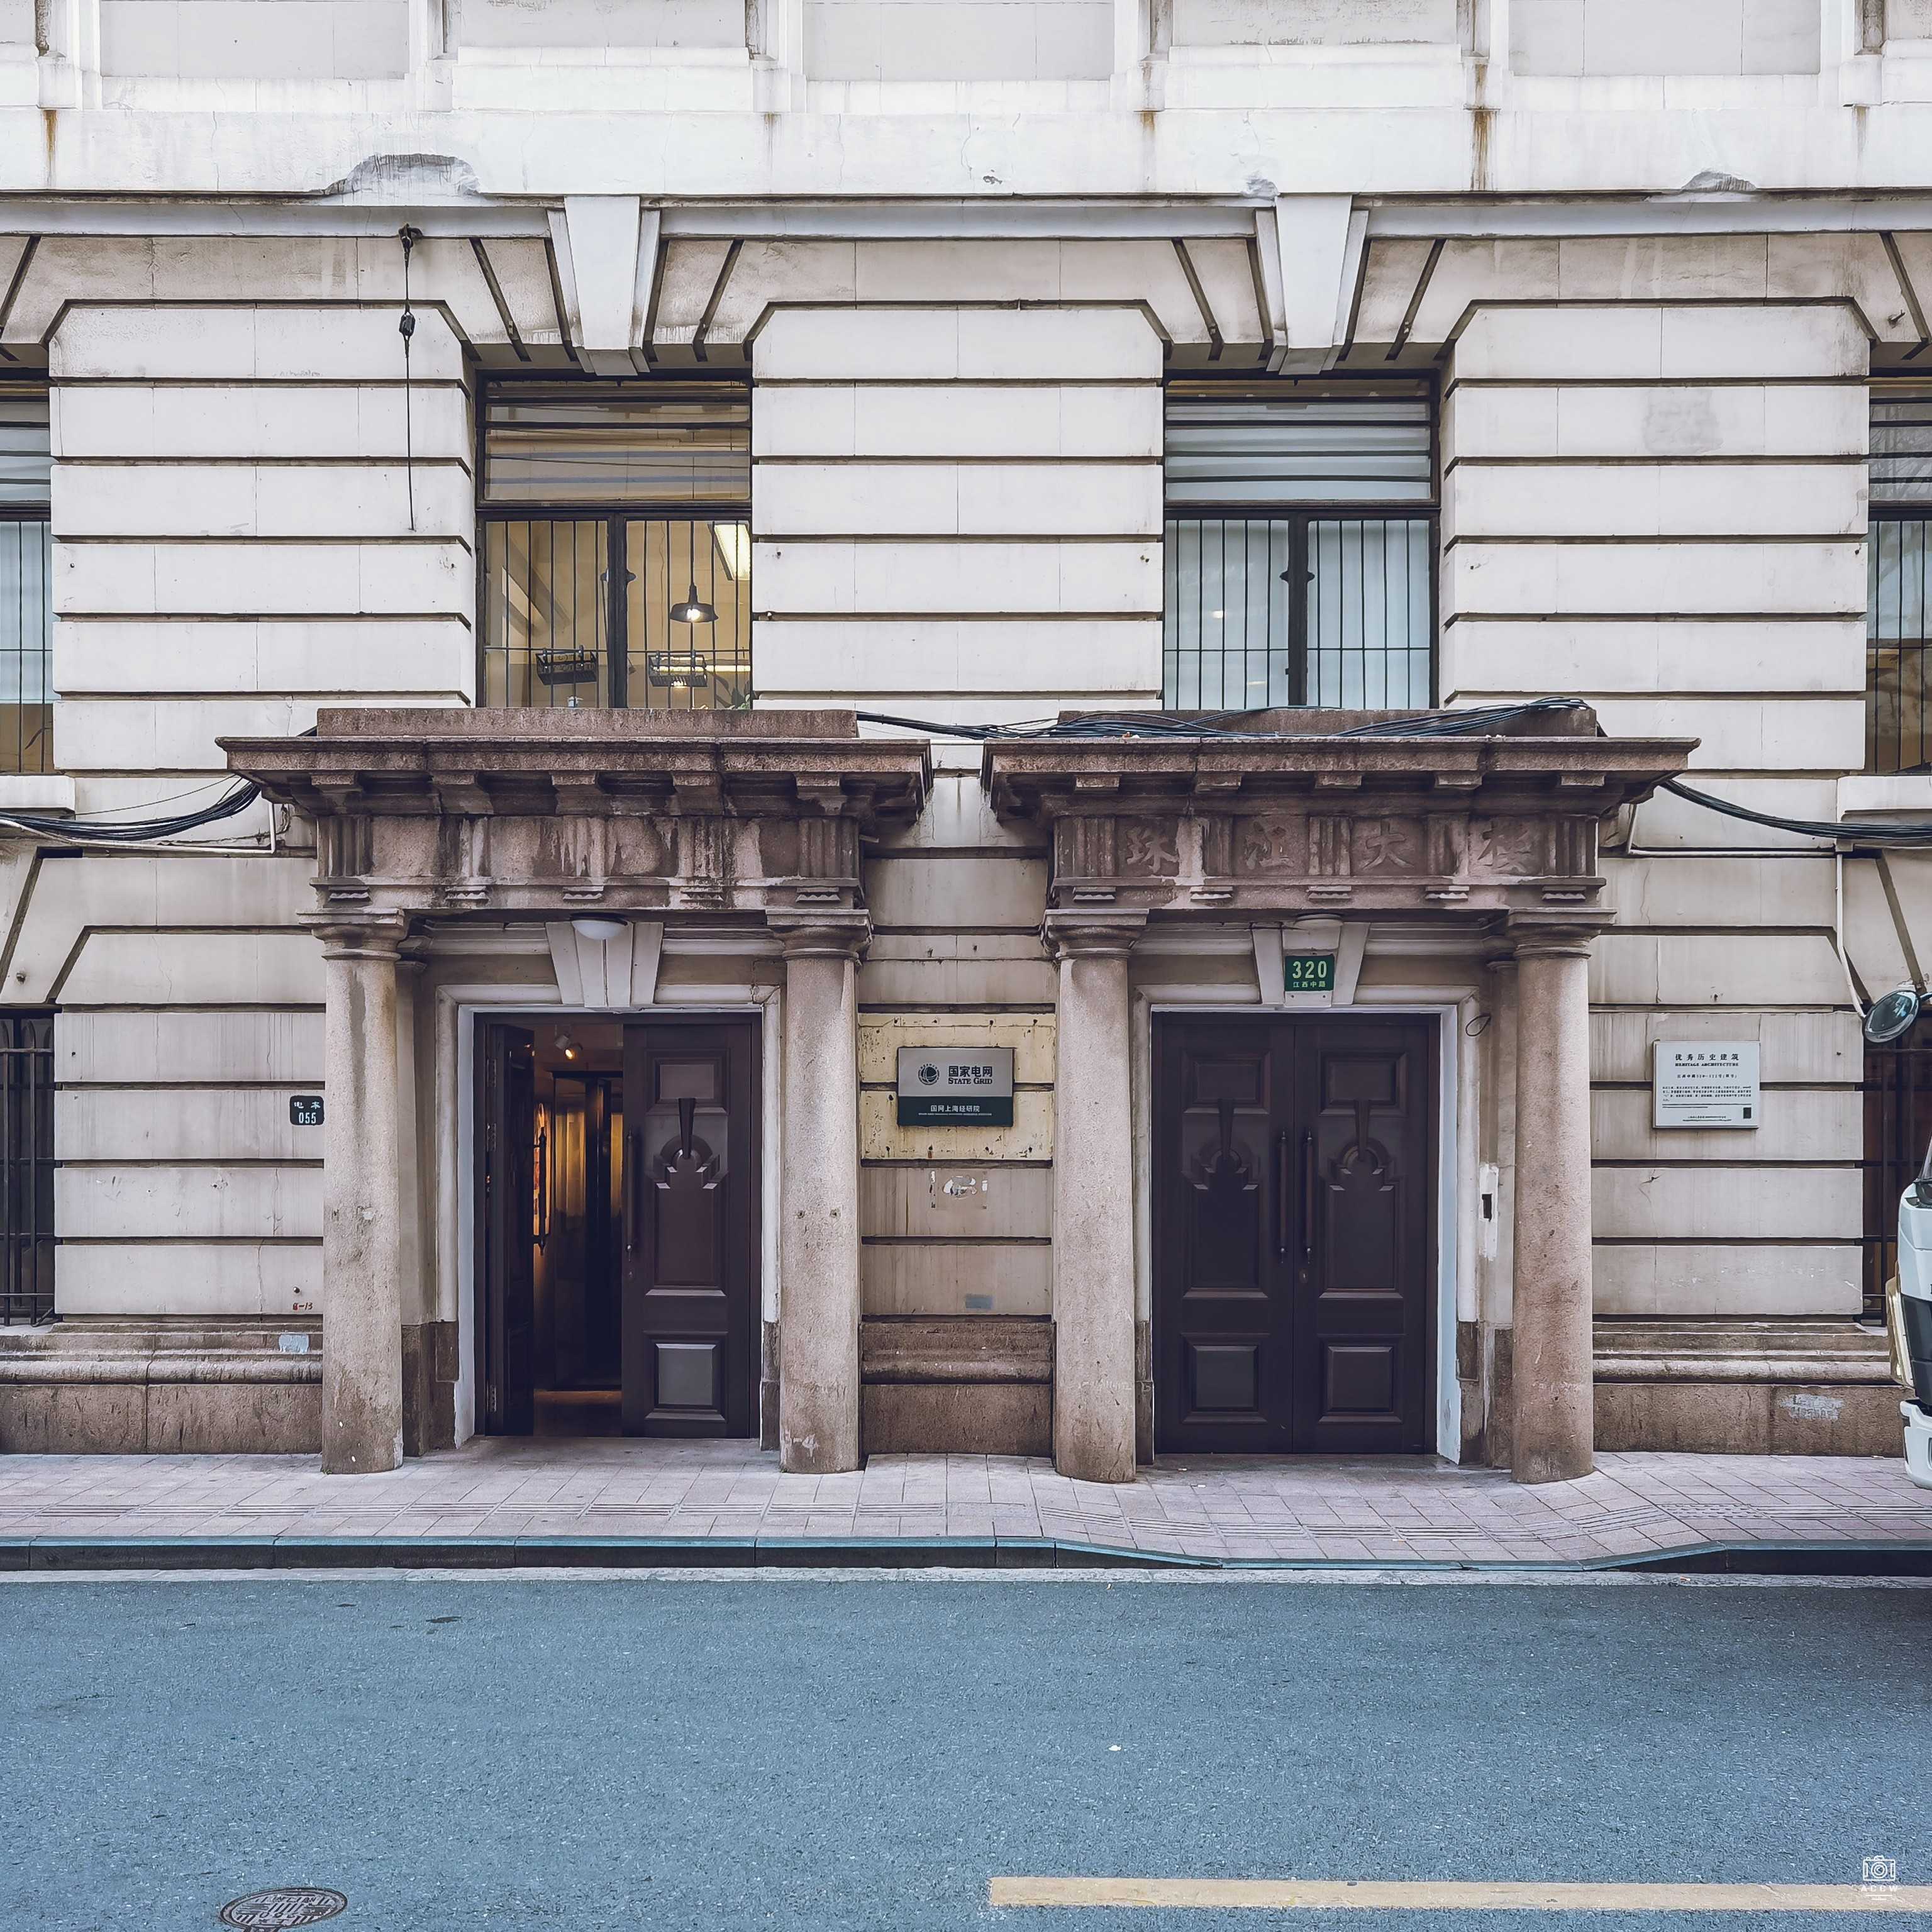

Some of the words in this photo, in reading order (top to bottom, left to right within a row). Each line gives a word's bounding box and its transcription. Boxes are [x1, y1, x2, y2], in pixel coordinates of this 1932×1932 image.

[1292, 961, 1327, 979] 320
[948, 1065, 993, 1077] 国家电网
[298, 1112, 317, 1124] 055
